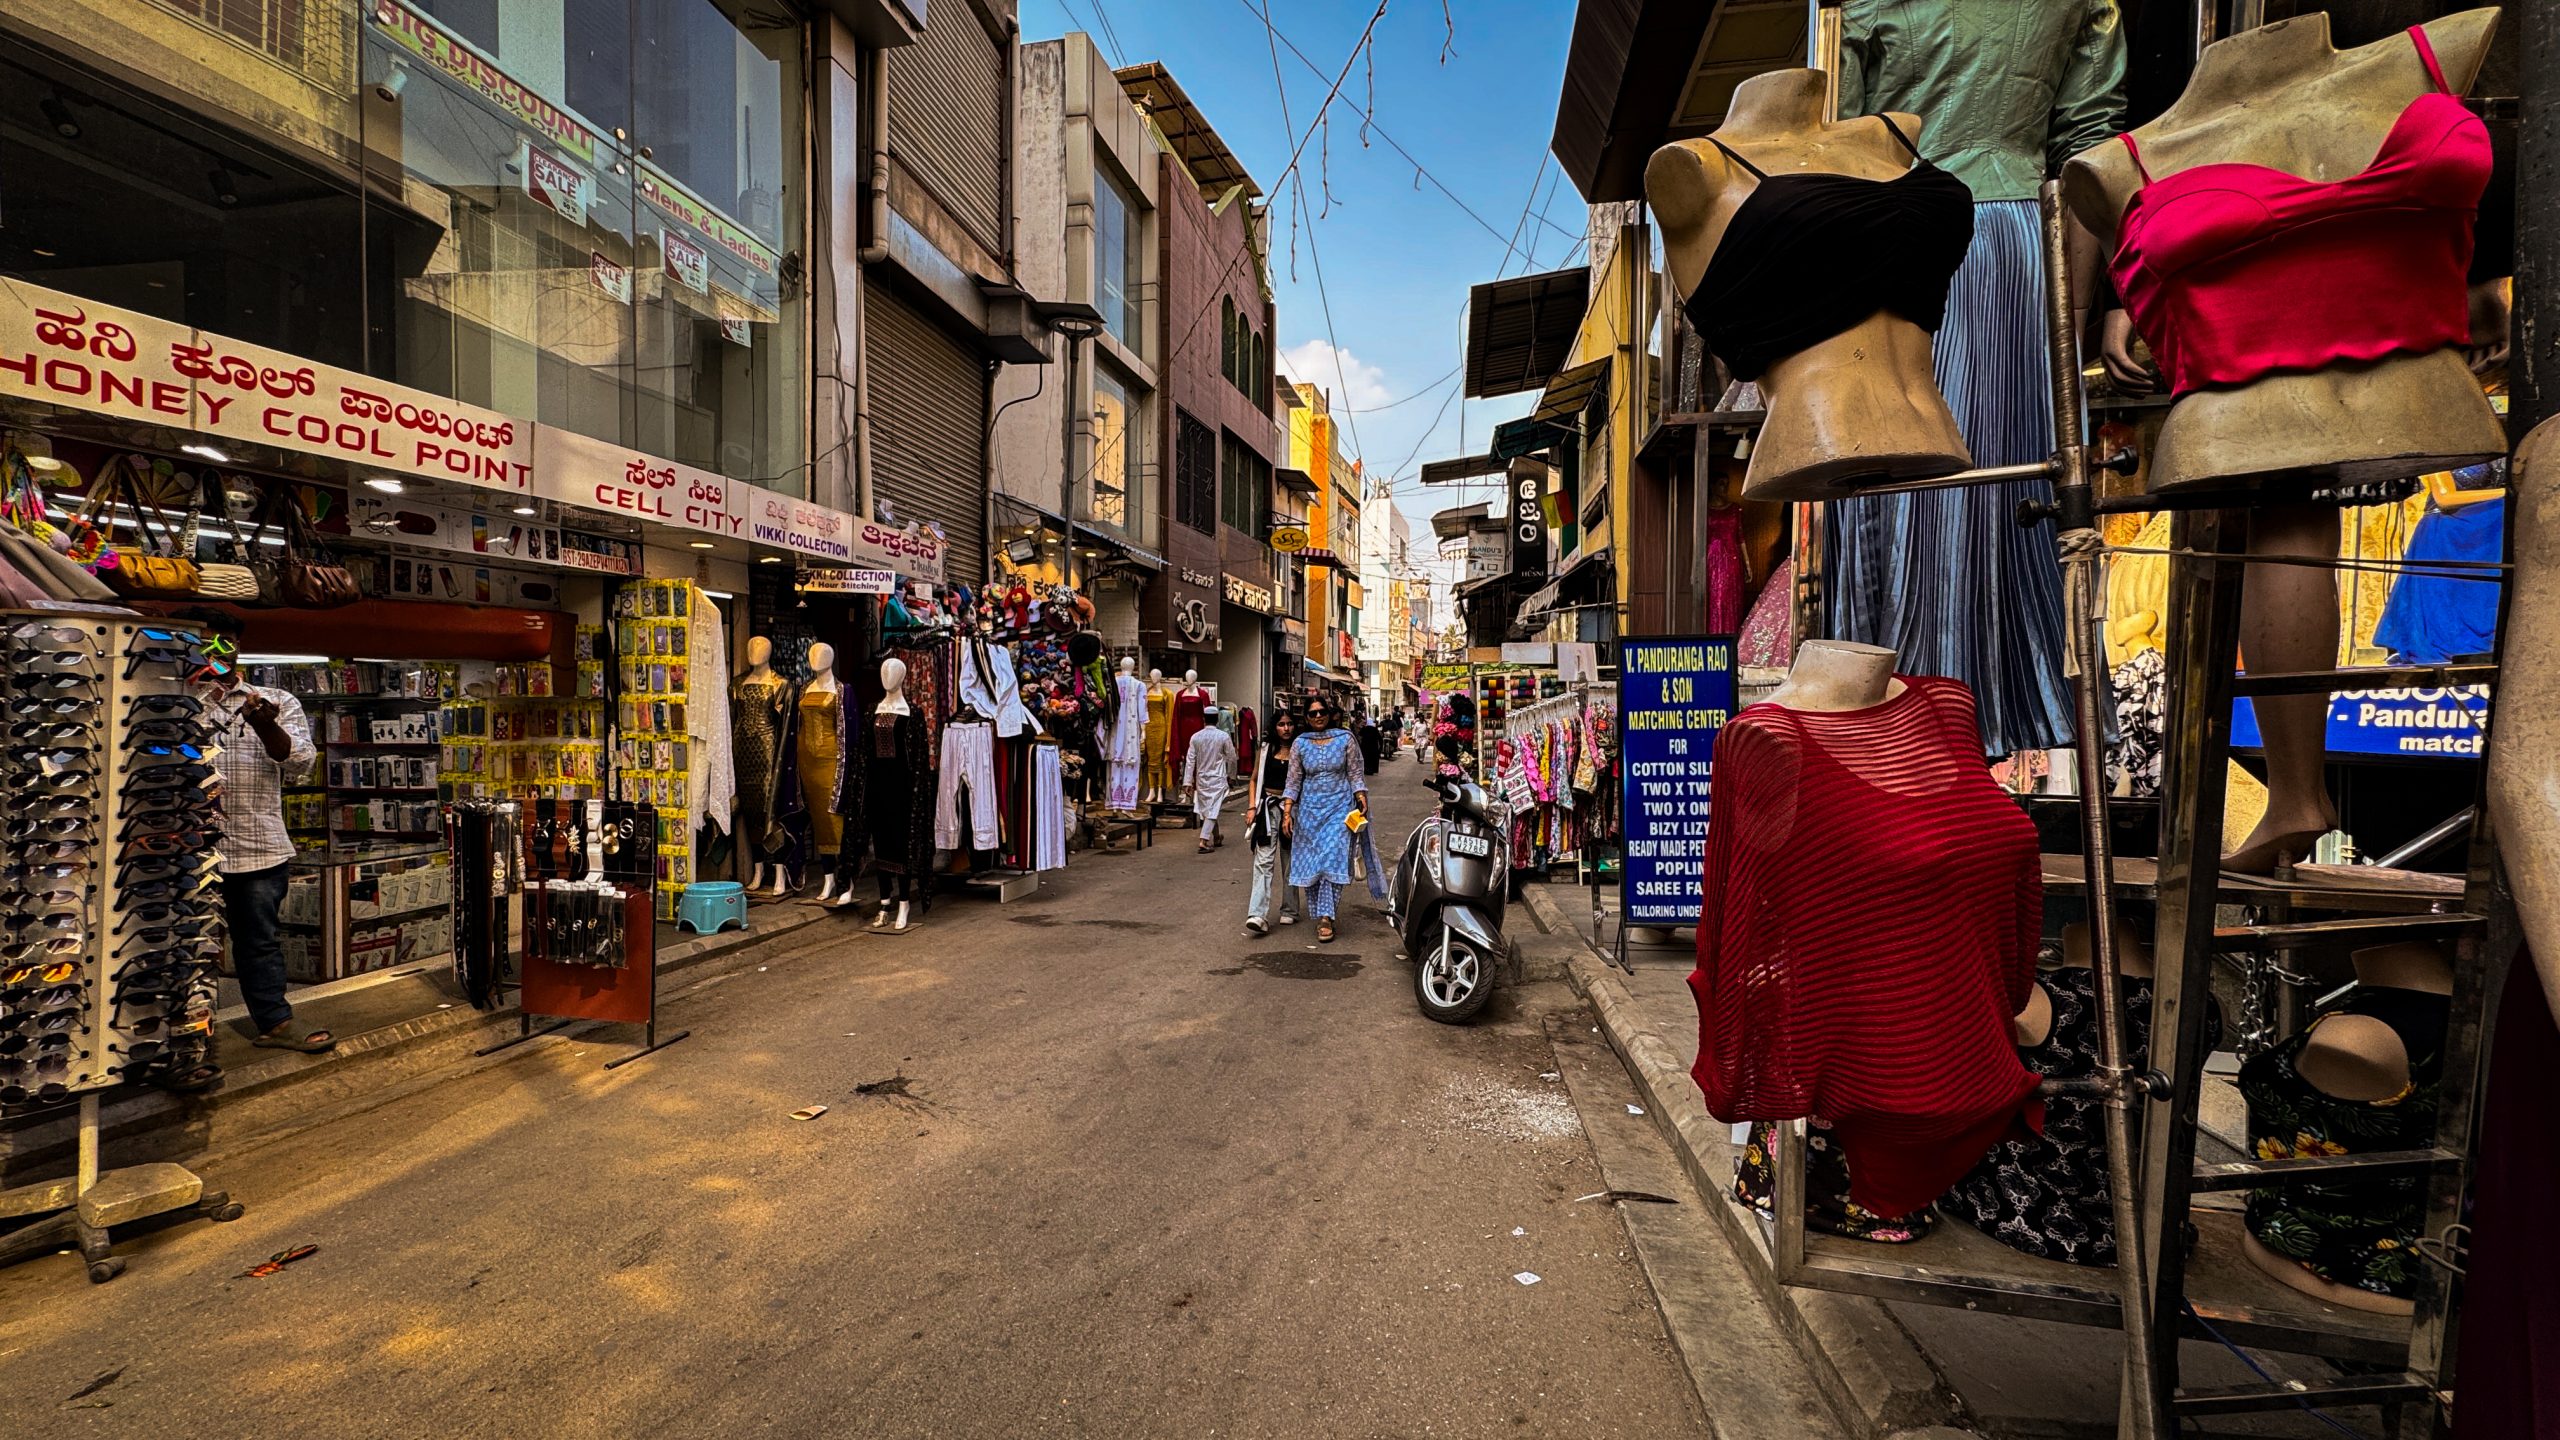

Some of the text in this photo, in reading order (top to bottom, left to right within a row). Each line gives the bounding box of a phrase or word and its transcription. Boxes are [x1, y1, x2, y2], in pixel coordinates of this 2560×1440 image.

[379, 0, 590, 149] BIG DISCOUNT
[534, 163, 576, 199] SALE
[643, 178, 769, 271] Mens & Ladies
[668, 244, 700, 273] SALE
[595, 261, 622, 284] SALE
[35, 305, 513, 449] ಹನಿ ಕೂಲ್ ಪಾಯಿಂಟ್
[263, 407, 396, 458] COOL
[416, 441, 533, 487] POINT
[626, 459, 722, 504] ಸೆಲ್ ಸಿಟಿ
[596, 484, 672, 518] CELL
[686, 505, 744, 534] CITY
[755, 523, 848, 557] VIKKI COLLECTION
[818, 581, 838, 589] Hour
[841, 581, 880, 591] Stitching
[829, 569, 893, 582] COLLECTION
[1625, 645, 1727, 673] V. PANDURANGA RAO
[1662, 677, 1693, 703] & SON
[1628, 709, 1727, 730] MATCHING CENTER
[1669, 738, 1688, 755] FOR
[1632, 761, 1685, 777] COTTON
[1641, 782, 1671, 796] TWO
[1675, 782, 1684, 796] X
[1643, 801, 1711, 816] TWO X ON
[1649, 821, 1710, 836] BIZY LIZY
[1628, 840, 1658, 857] READY
[1660, 840, 1687, 857] MADE
[1655, 861, 1705, 876] POPLIN
[1636, 881, 1681, 897] SAREE
[1632, 904, 1676, 918] TAILORING
